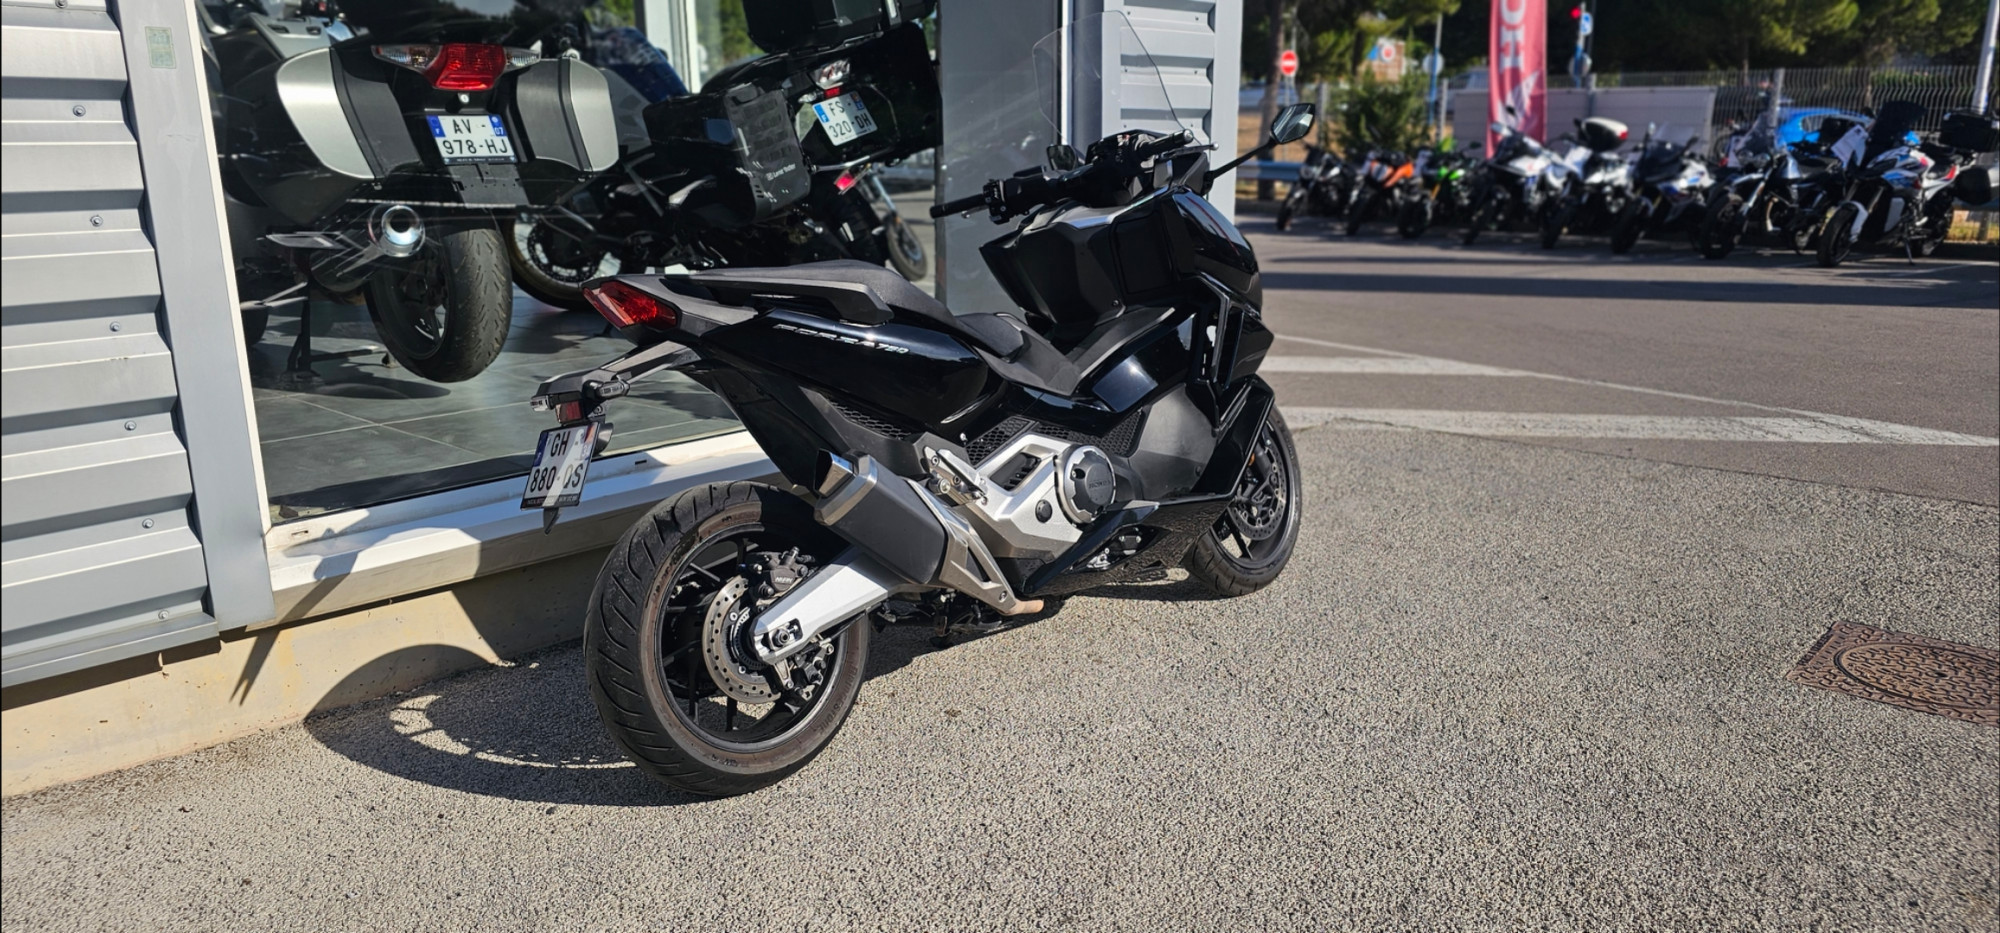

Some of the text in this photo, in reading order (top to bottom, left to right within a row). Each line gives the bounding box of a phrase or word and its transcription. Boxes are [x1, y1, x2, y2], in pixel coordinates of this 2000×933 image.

[452, 118, 472, 134] AV
[442, 139, 508, 155] 978-HJ
[550, 430, 571, 457] GH
